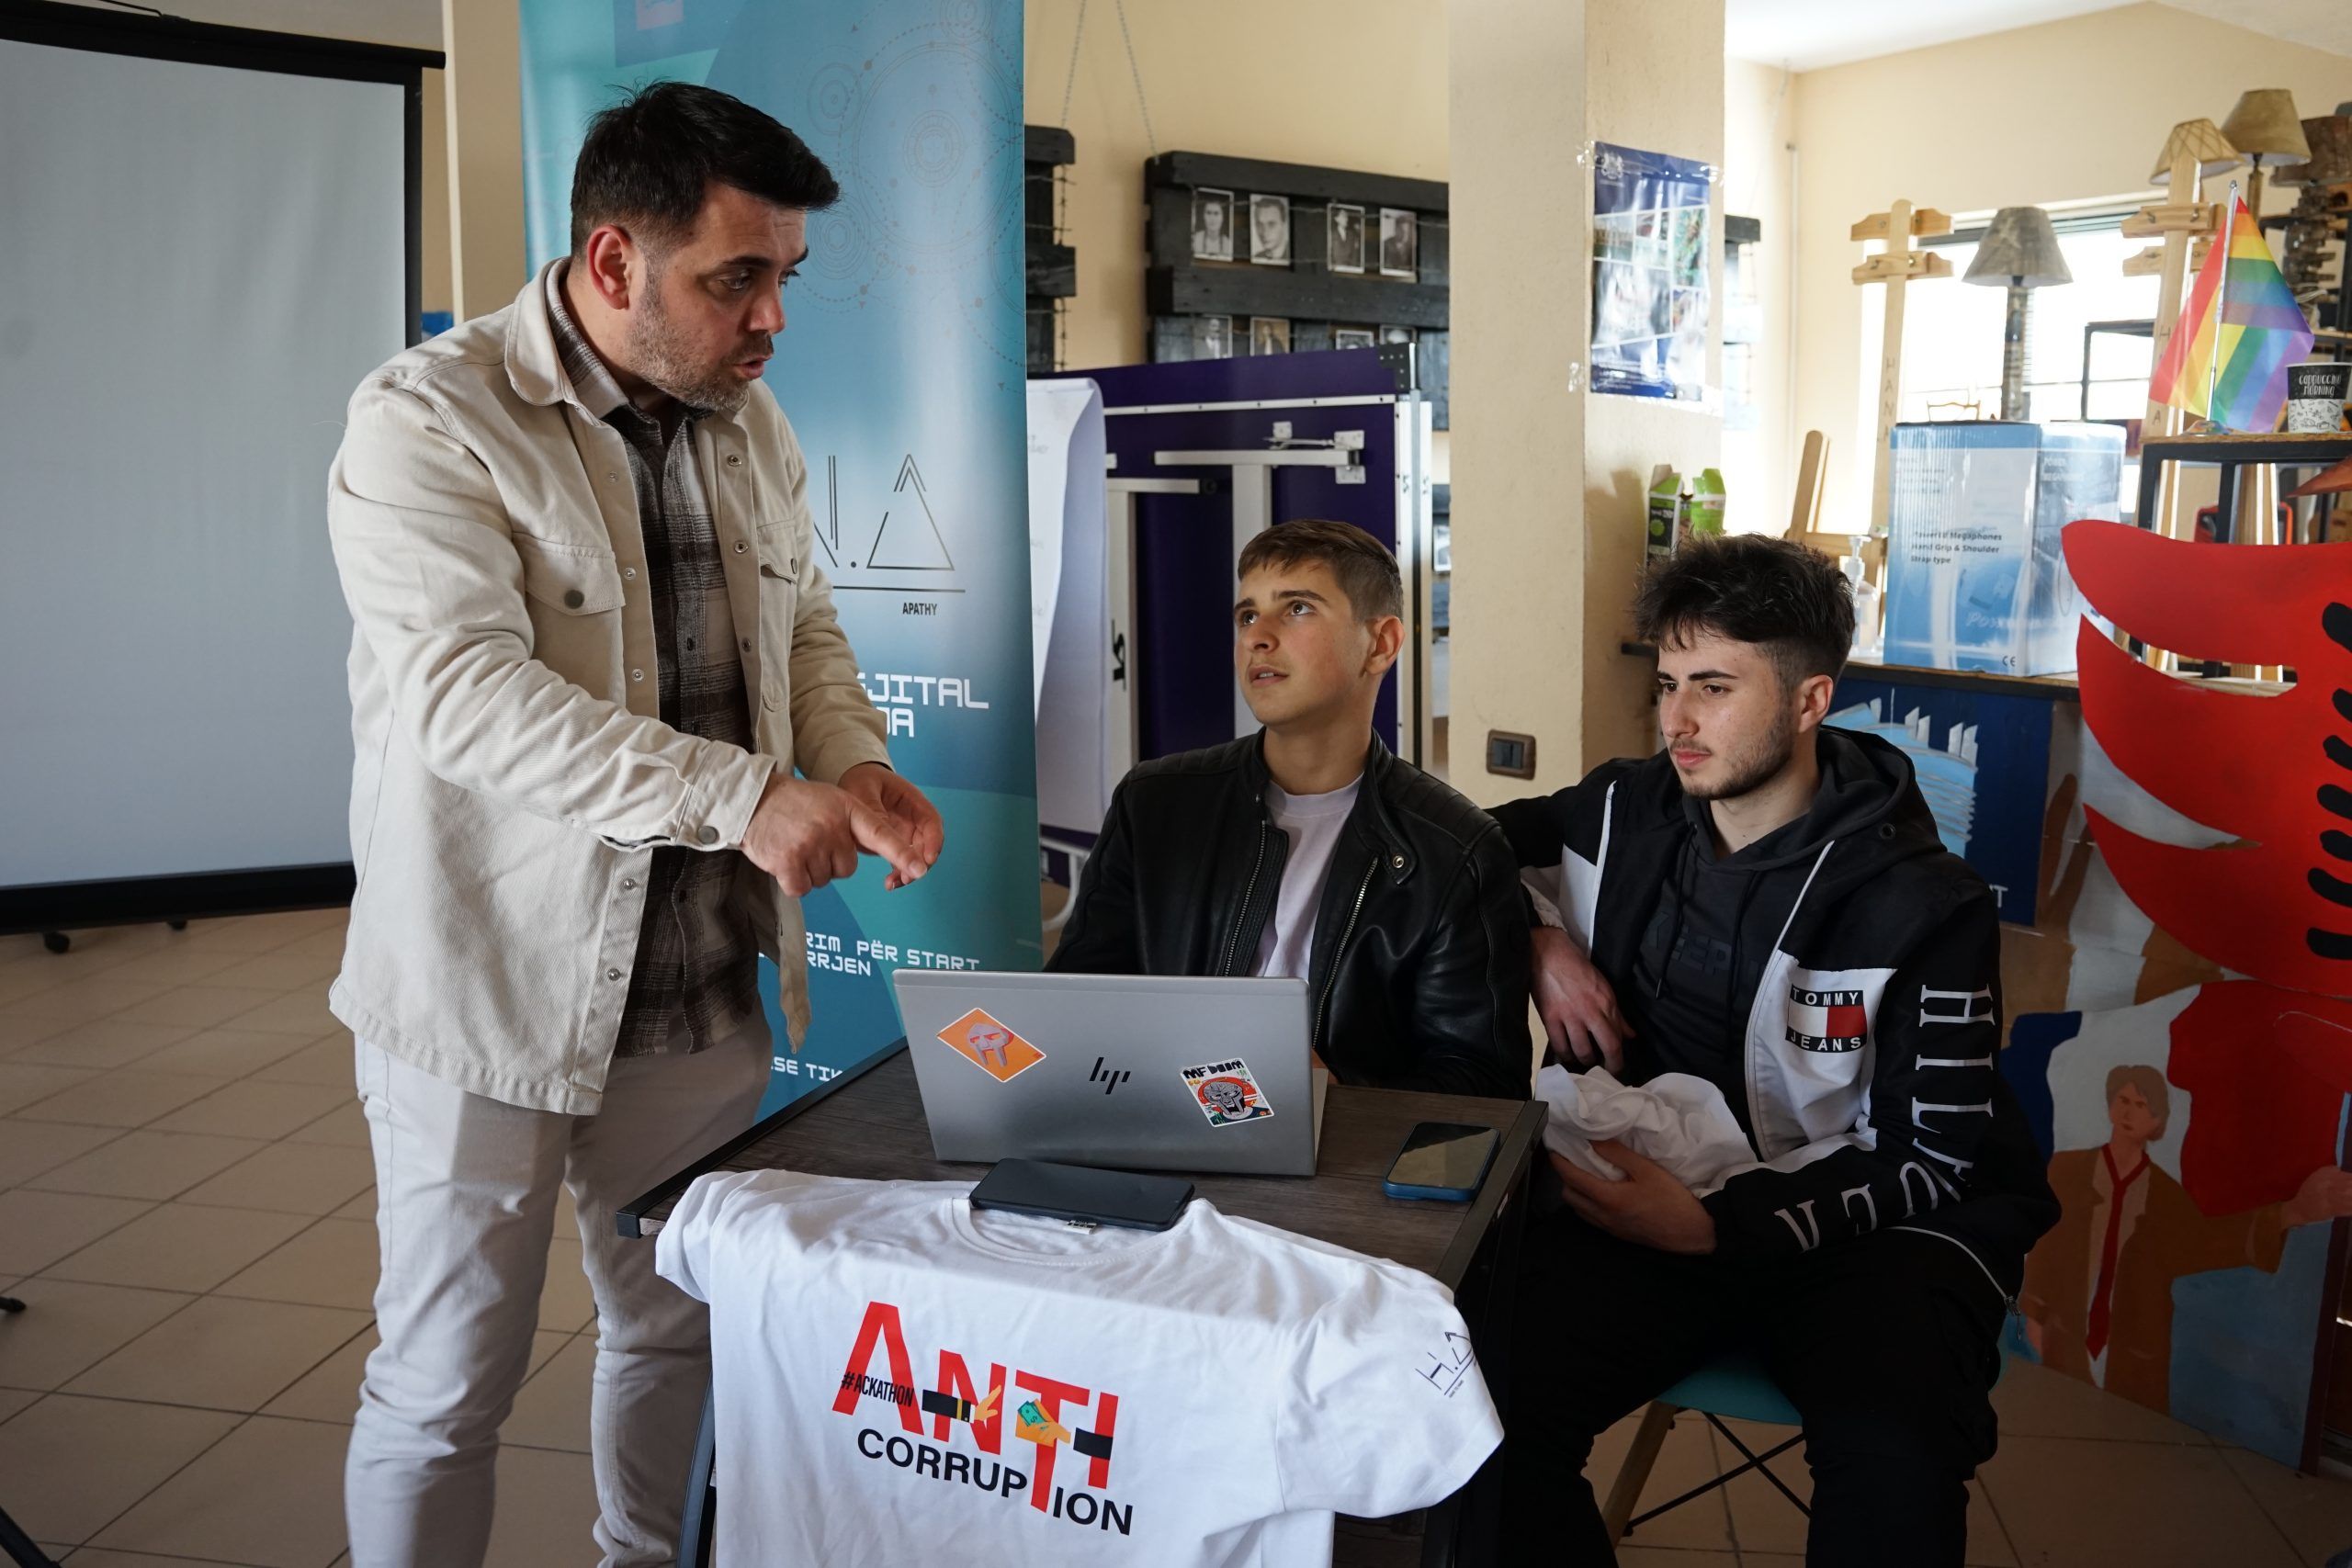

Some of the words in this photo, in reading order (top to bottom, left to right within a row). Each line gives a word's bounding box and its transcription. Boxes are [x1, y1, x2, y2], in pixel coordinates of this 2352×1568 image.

[1950, 531, 2003, 542] Megaphones
[1935, 543, 1952, 553] Grip
[1962, 545, 2000, 554] Shoulder
[1910, 555, 1931, 564] Strap
[1933, 556, 1951, 566] type
[902, 602, 938, 616] APATHY
[856, 939, 899, 963] PËR
[907, 948, 980, 971] START
[1792, 987, 1859, 1006] TOMMY
[1791, 1031, 1861, 1052] JEANS
[771, 1055, 799, 1076] SE
[1089, 1056, 1131, 1095] hp
[1182, 1066, 1206, 1079] MF
[841, 1371, 915, 1408] #ACKATHON
[831, 1300, 1119, 1514] ANTI
